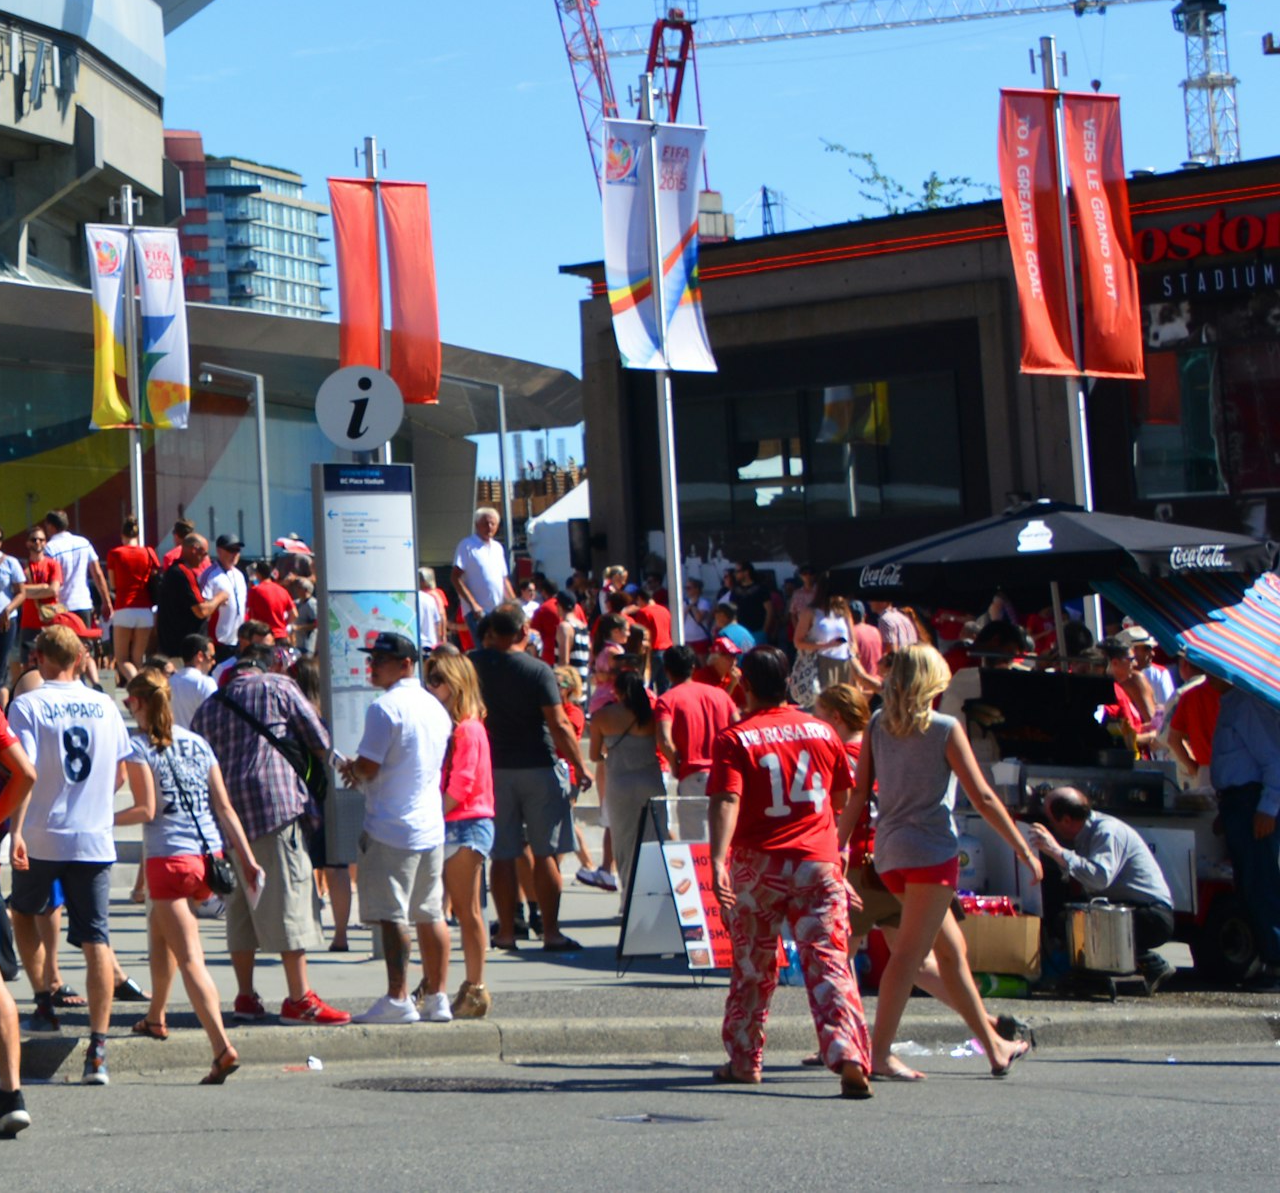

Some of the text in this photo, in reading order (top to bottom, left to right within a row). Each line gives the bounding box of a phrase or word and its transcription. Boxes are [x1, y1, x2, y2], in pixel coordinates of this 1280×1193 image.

[662, 145, 691, 159] FIFA
[658, 176, 687, 191] 2015
[1017, 115, 1043, 298] TO A GREATER GOAL
[1083, 118, 1118, 300] VERS LE GRAND BUT
[1133, 207, 1280, 264] osto
[144, 249, 171, 262] FIFA
[146, 266, 175, 281] 2015
[1162, 263, 1275, 297] STADIUM
[1169, 544, 1227, 571] Coca-Cola
[859, 563, 904, 589] Coca-Cola
[763, 722, 832, 743] ROSARIO
[63, 725, 92, 783] 8
[758, 749, 827, 818] 14
[692, 856, 711, 866] HO
